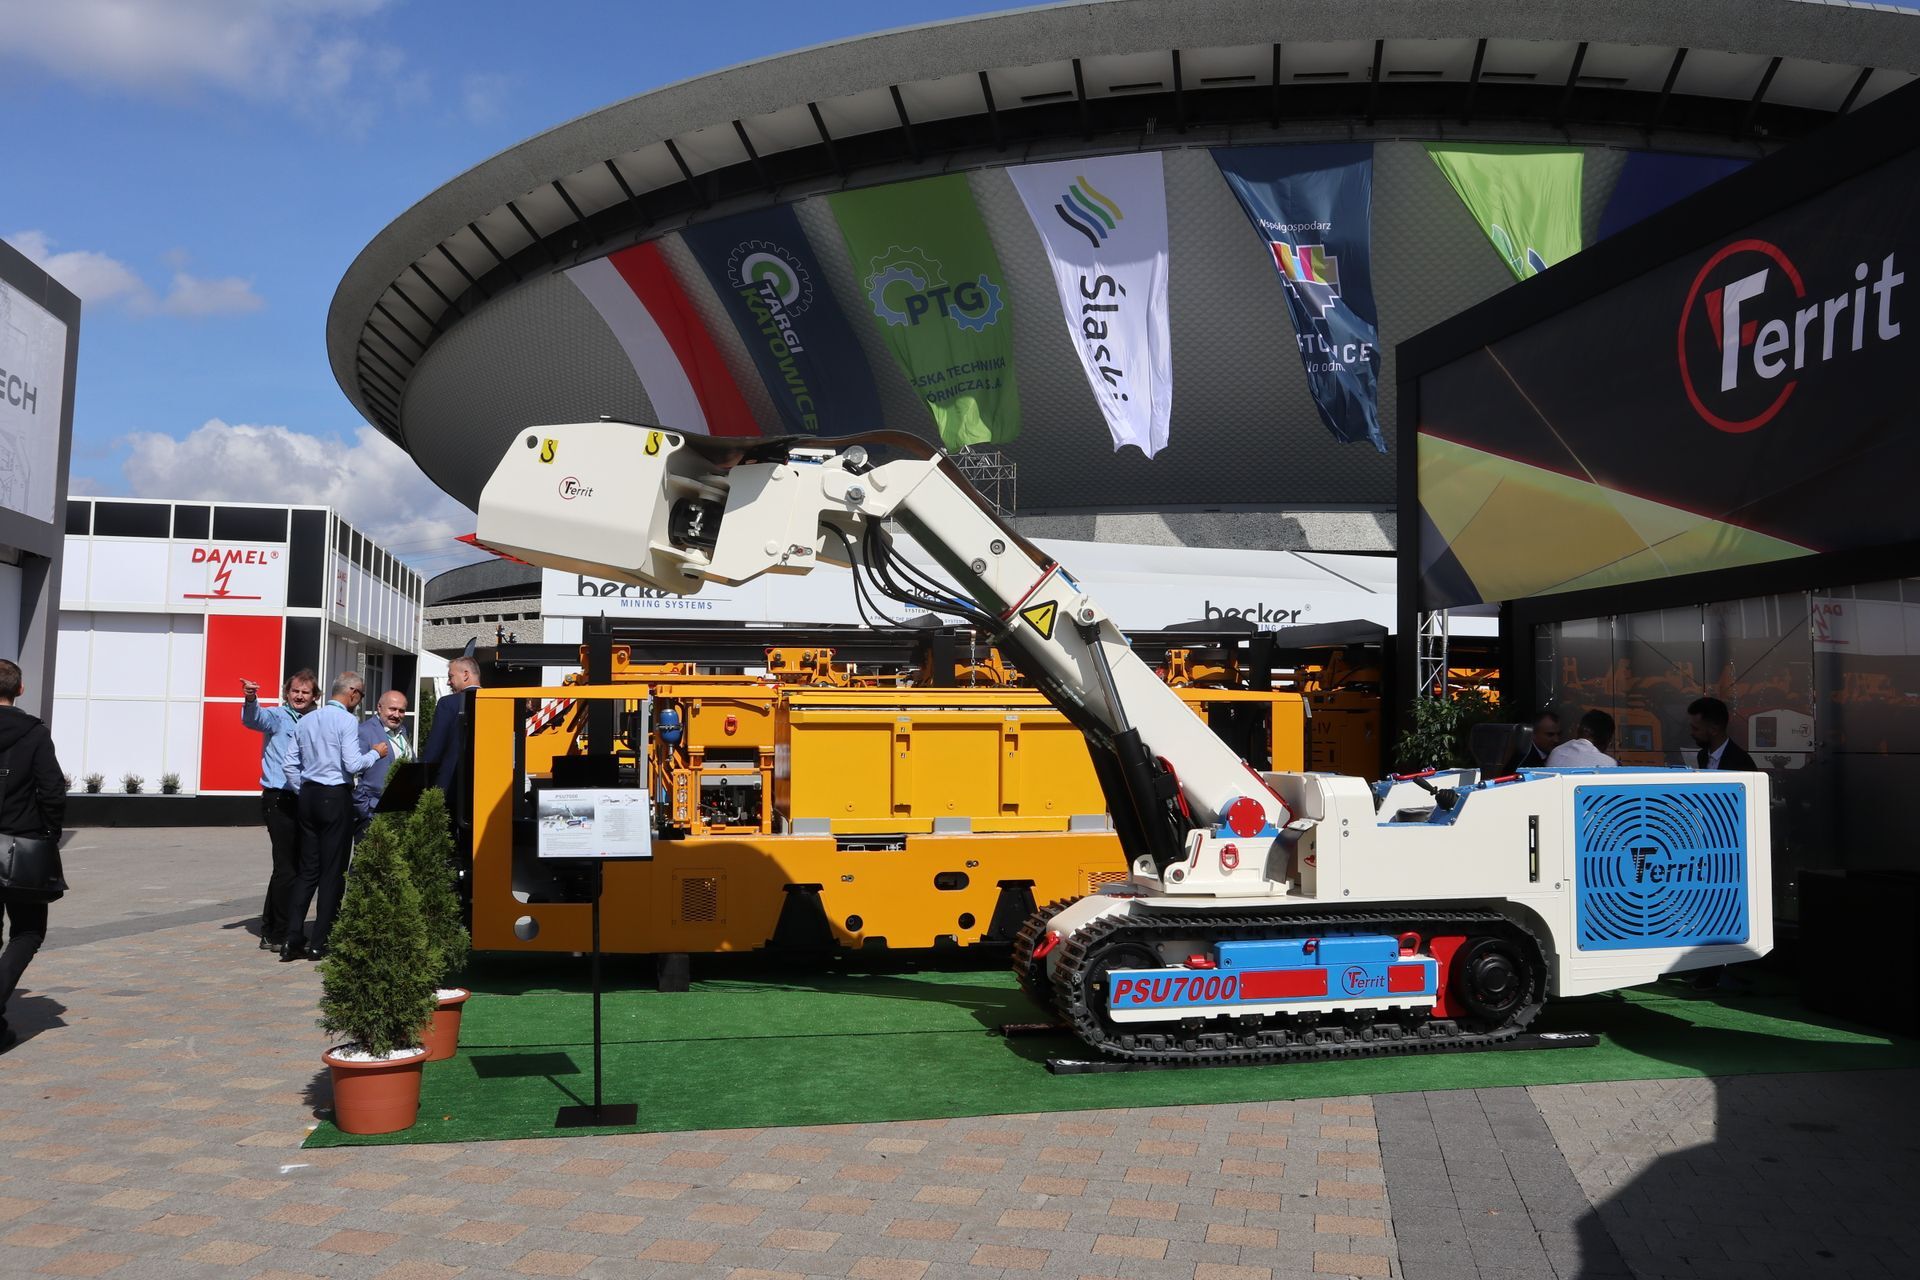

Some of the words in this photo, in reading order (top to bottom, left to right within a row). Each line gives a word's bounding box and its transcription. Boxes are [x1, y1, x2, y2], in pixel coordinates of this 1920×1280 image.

[904, 282, 986, 325] PTG
[759, 283, 804, 354] TARGI
[1704, 252, 1905, 392] Ferrit
[739, 287, 819, 430] KATOWICE
[926, 380, 984, 403] ÓRNICZA
[565, 481, 593, 497] Ferrit
[192, 548, 267, 564] DAMEL
[621, 600, 660, 608] MINING
[665, 600, 713, 610] SYSTEMS
[1630, 847, 1707, 883] Ferrit
[1113, 975, 1237, 1004] PSU7000
[1348, 972, 1385, 989] Ferrit
